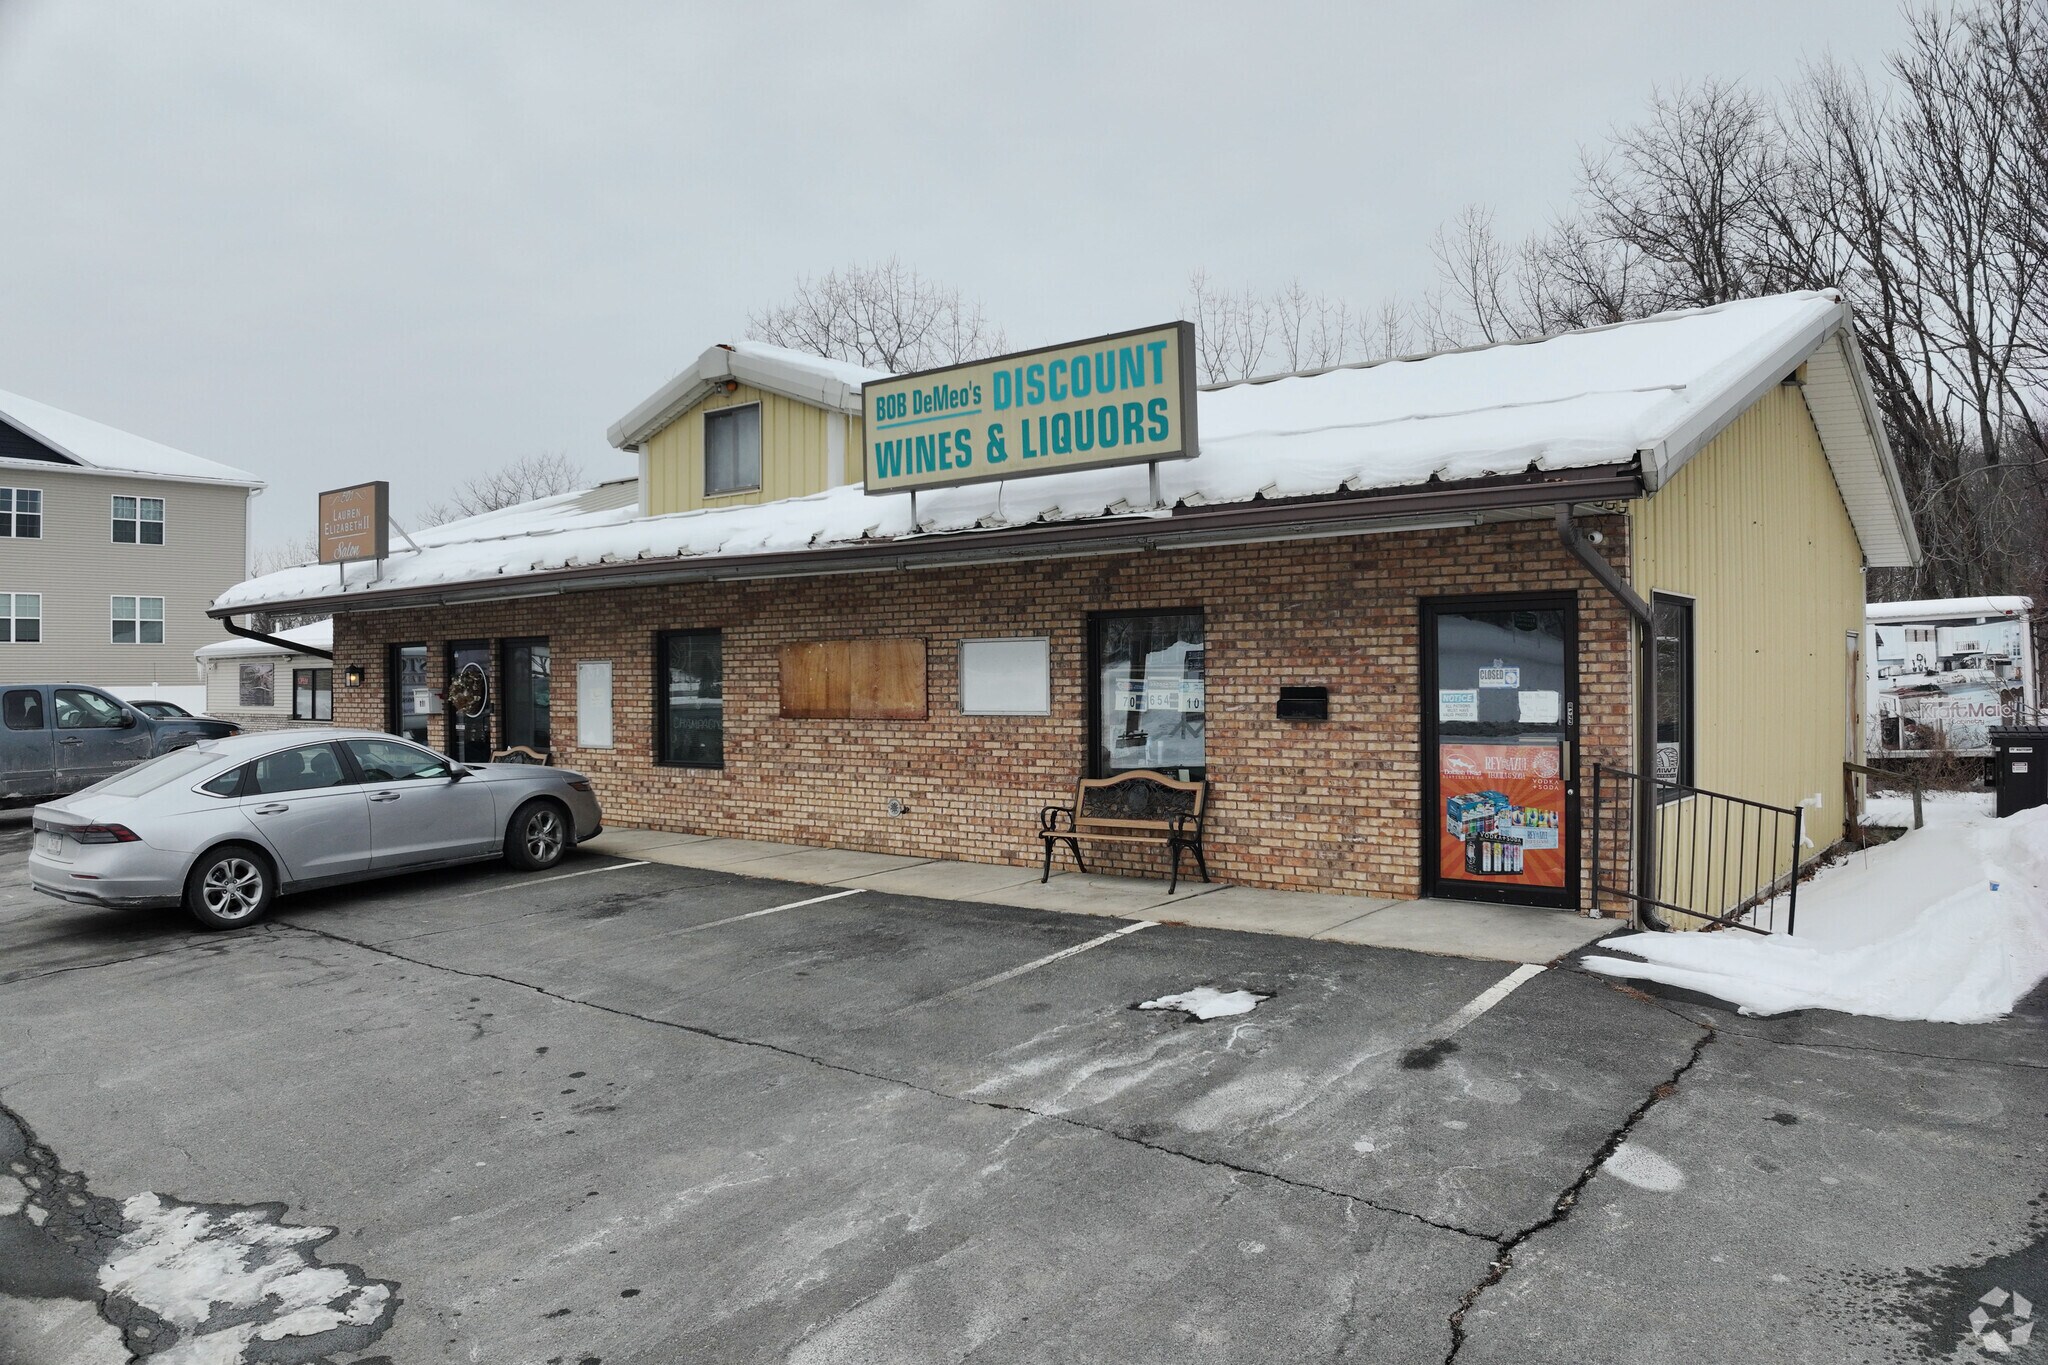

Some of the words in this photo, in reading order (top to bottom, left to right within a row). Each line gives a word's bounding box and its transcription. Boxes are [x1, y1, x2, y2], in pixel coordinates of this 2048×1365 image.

[993, 340, 1168, 411] DISCOUNT
[876, 392, 906, 421] BOB
[913, 380, 982, 415] DeMeo's
[875, 428, 972, 479] WINES
[986, 423, 1008, 464] &
[1021, 398, 1169, 459] LIQUORS
[333, 508, 361, 522] LAUREN
[333, 541, 360, 560] Salon
[1480, 669, 1504, 680] CLOSED
[1150, 694, 1169, 706] 654
[1187, 697, 1200, 709] 10
[1442, 694, 1474, 702] NOTICE
[673, 716, 722, 730] CHAMPAGN
